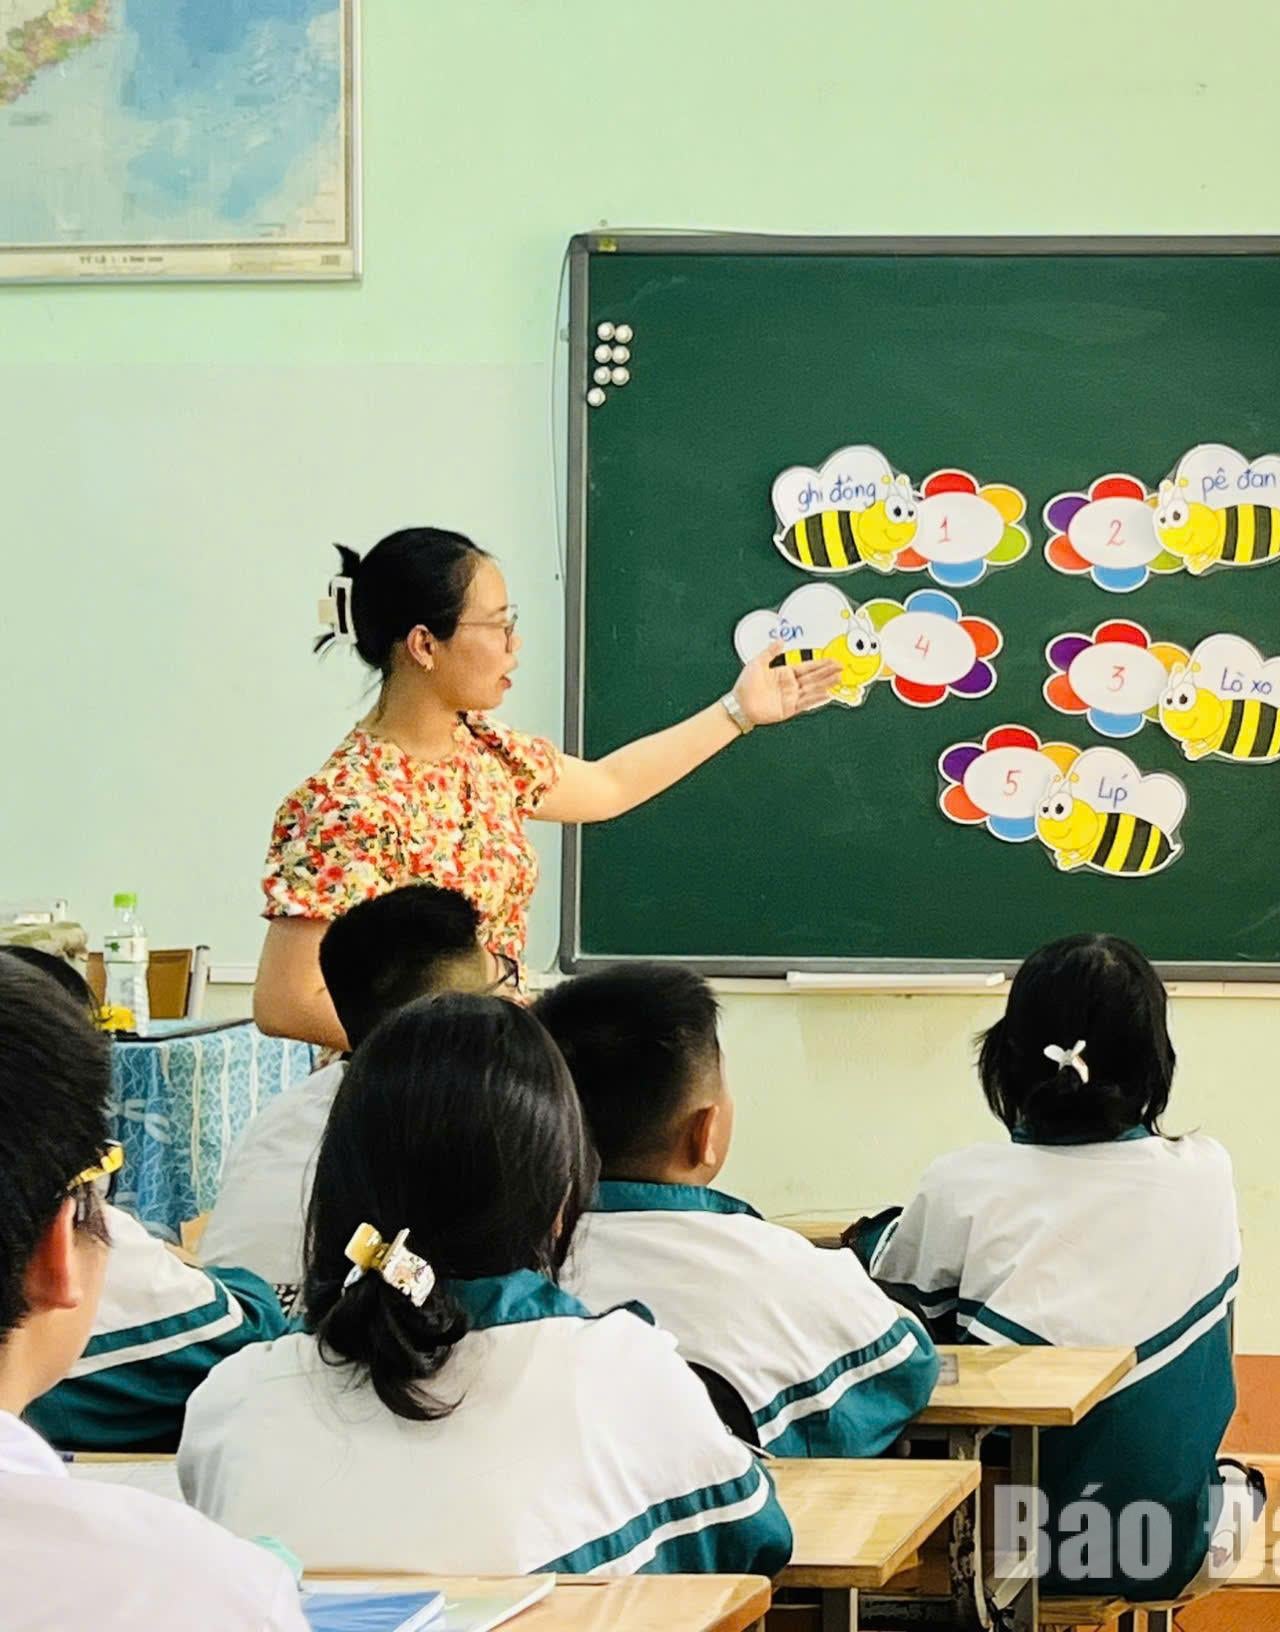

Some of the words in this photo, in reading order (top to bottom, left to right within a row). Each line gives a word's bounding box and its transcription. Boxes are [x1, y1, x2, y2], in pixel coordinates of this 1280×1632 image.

[798, 482, 824, 512] ghi
[1201, 467, 1229, 501] pê
[1236, 467, 1277, 490] đan
[937, 516, 951, 544] 1
[1105, 519, 1126, 547] 2
[914, 634, 931, 658] 4
[1107, 664, 1127, 692] 3
[1249, 679, 1273, 696] xo
[1003, 769, 1024, 797] 5
